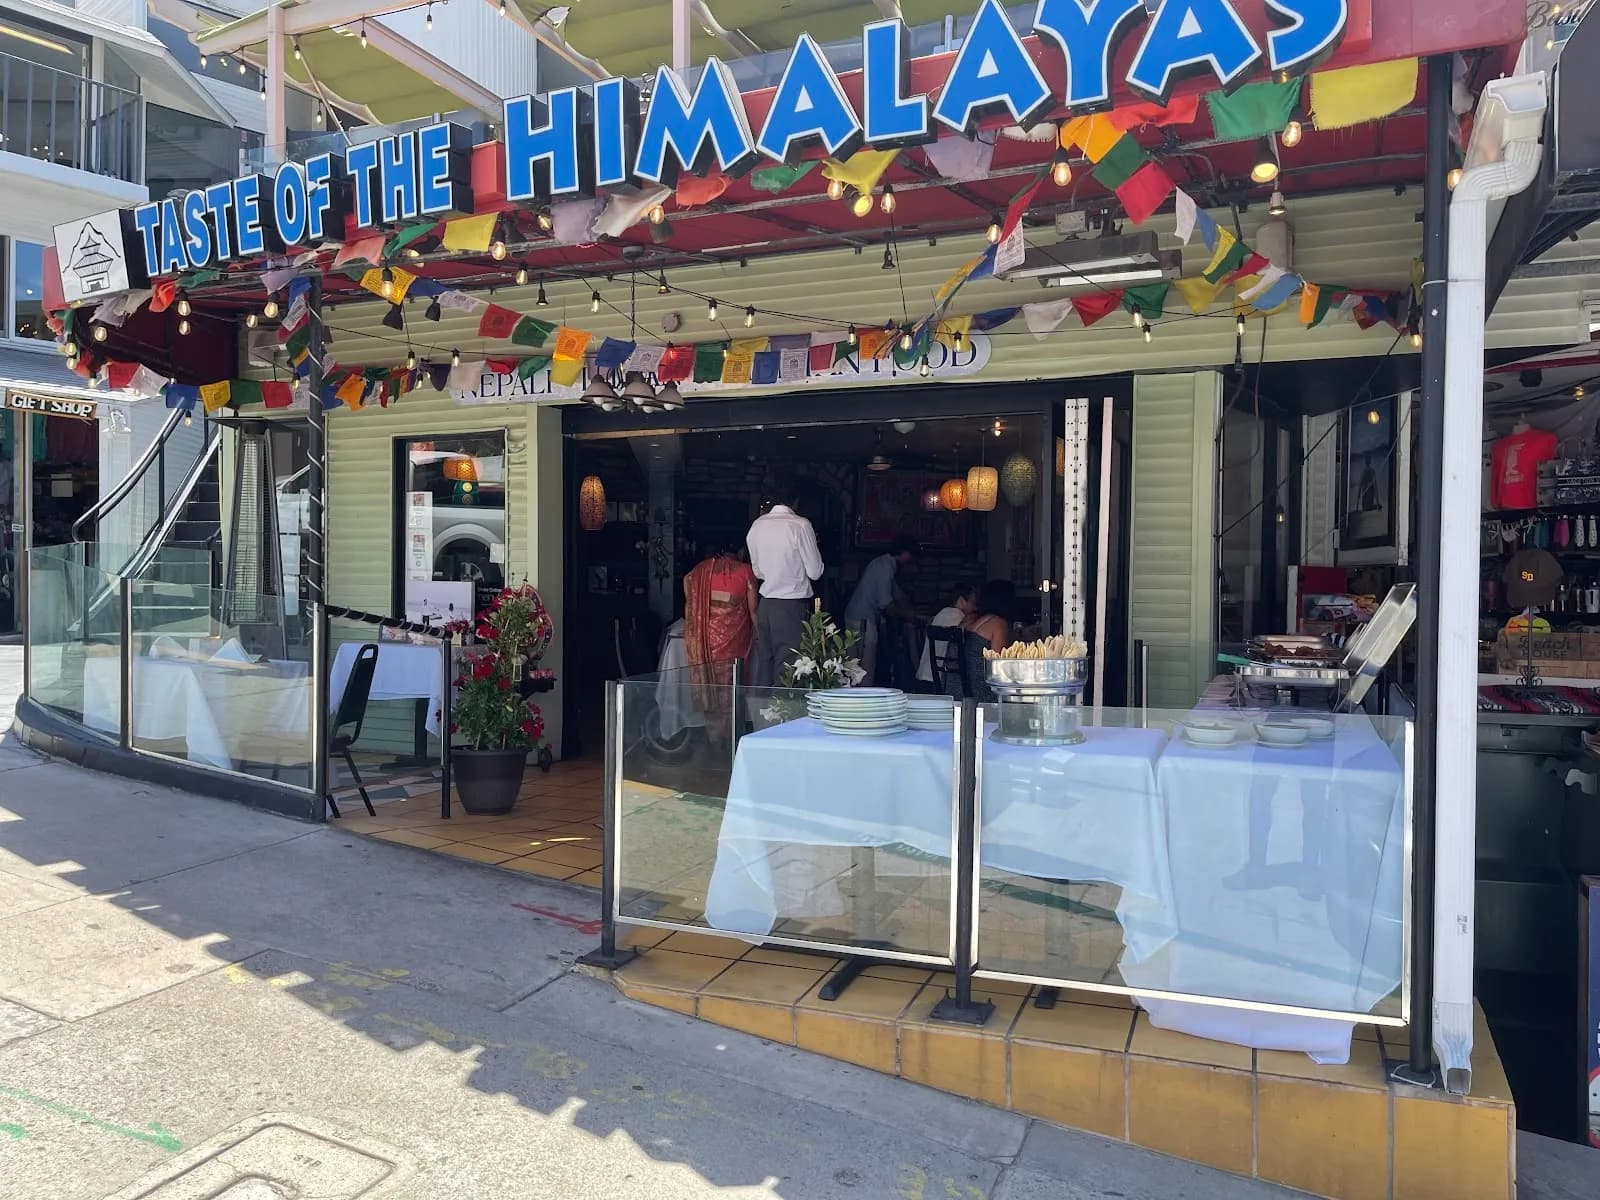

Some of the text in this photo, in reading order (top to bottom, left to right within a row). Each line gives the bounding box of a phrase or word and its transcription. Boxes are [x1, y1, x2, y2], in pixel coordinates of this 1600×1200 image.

[134, 0, 1348, 277] TASTE OF THE HIMALAYAS
[11, 394, 93, 417] GIFT SHOP
